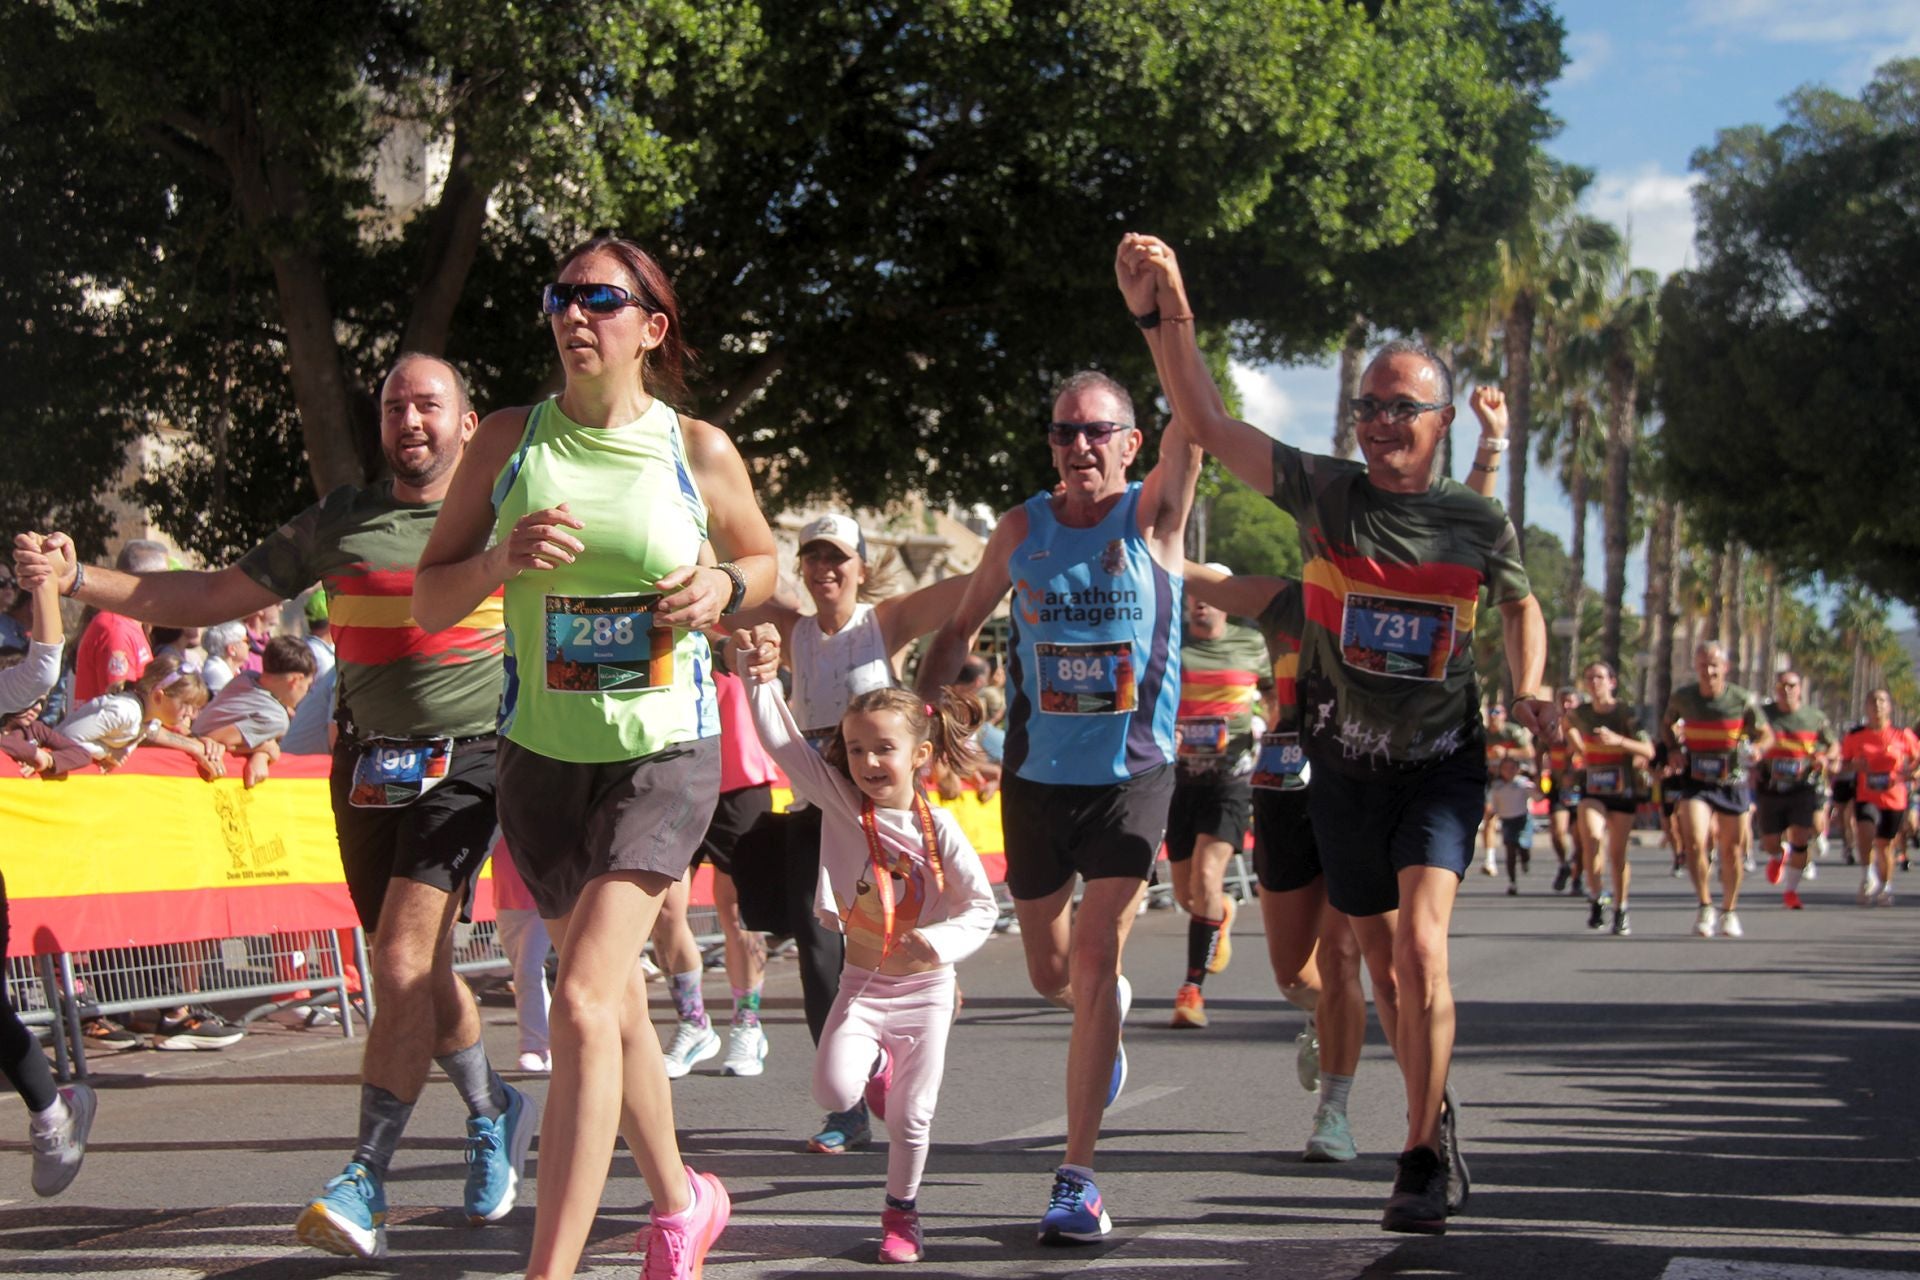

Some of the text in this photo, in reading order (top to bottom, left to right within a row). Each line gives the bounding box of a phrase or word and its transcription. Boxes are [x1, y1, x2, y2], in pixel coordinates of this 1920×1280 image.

[1018, 588, 1143, 627] Cartagena
[1027, 586, 1137, 606] Marathon
[572, 616, 634, 646] 288
[1373, 613, 1421, 641] 731
[1057, 658, 1104, 681] 894
[451, 847, 470, 869] FILA
